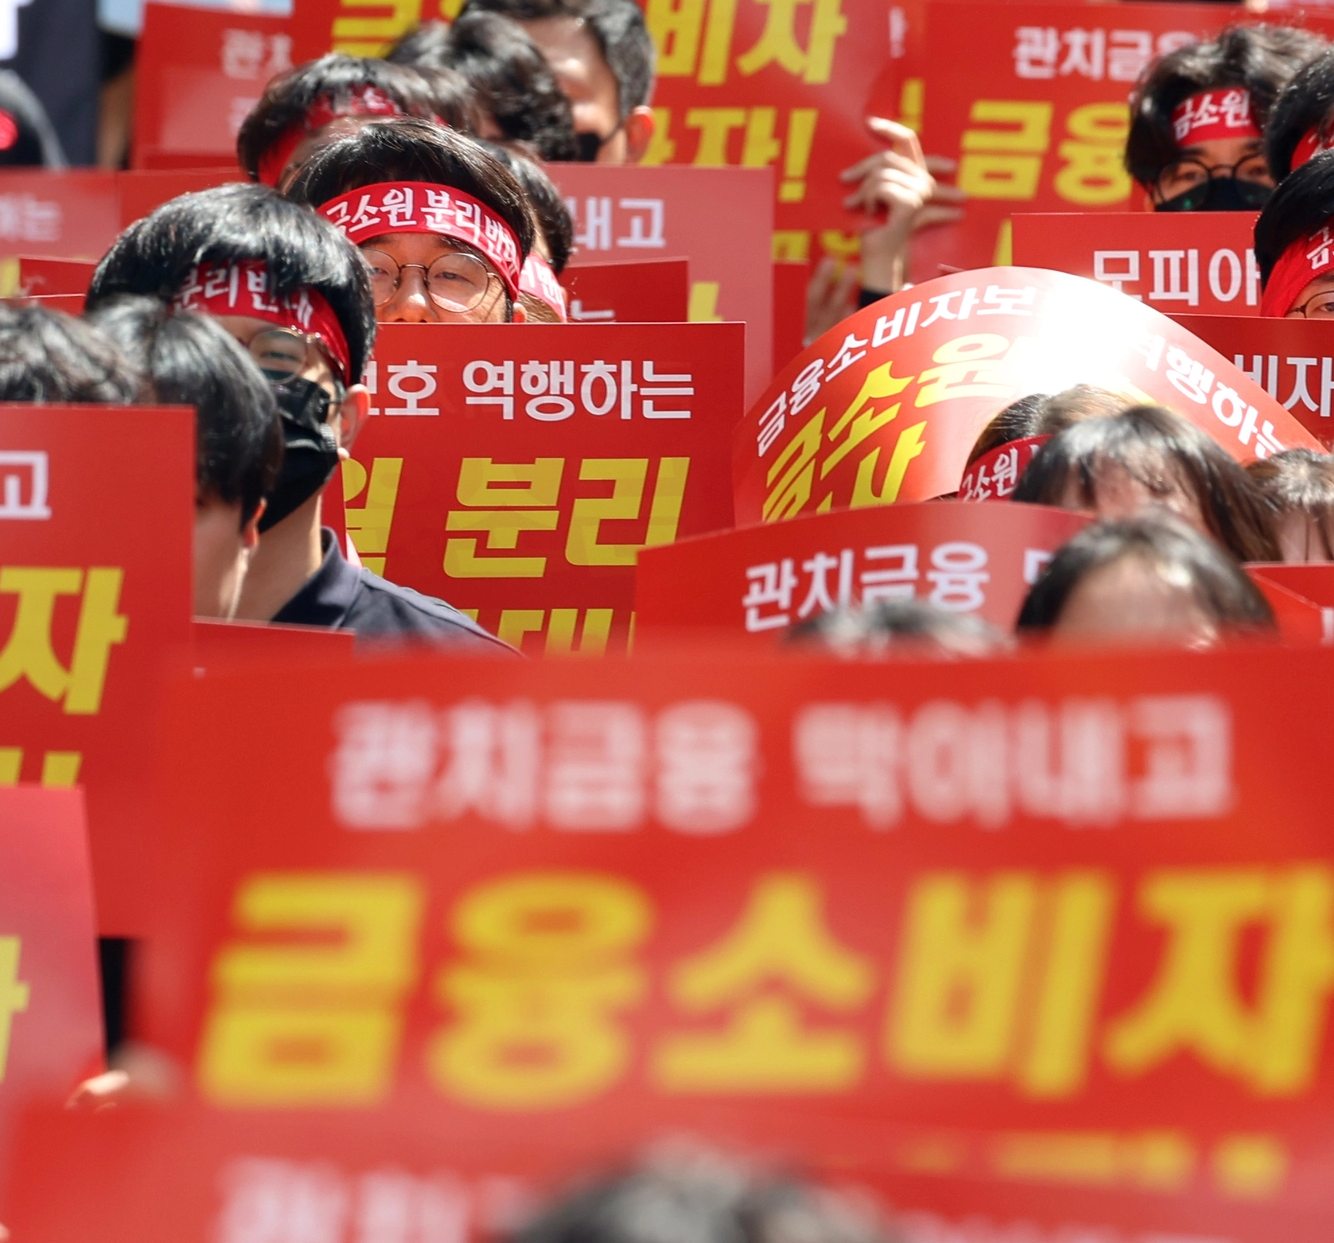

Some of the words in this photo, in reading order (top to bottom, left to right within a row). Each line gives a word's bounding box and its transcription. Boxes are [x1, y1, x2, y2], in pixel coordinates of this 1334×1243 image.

[1093, 247, 1259, 309] 모피아
[463, 359, 695, 423] 역행하는
[443, 457, 690, 579] 분리
[329, 699, 759, 835] 관치금융
[792, 694, 1237, 829] 막아내고
